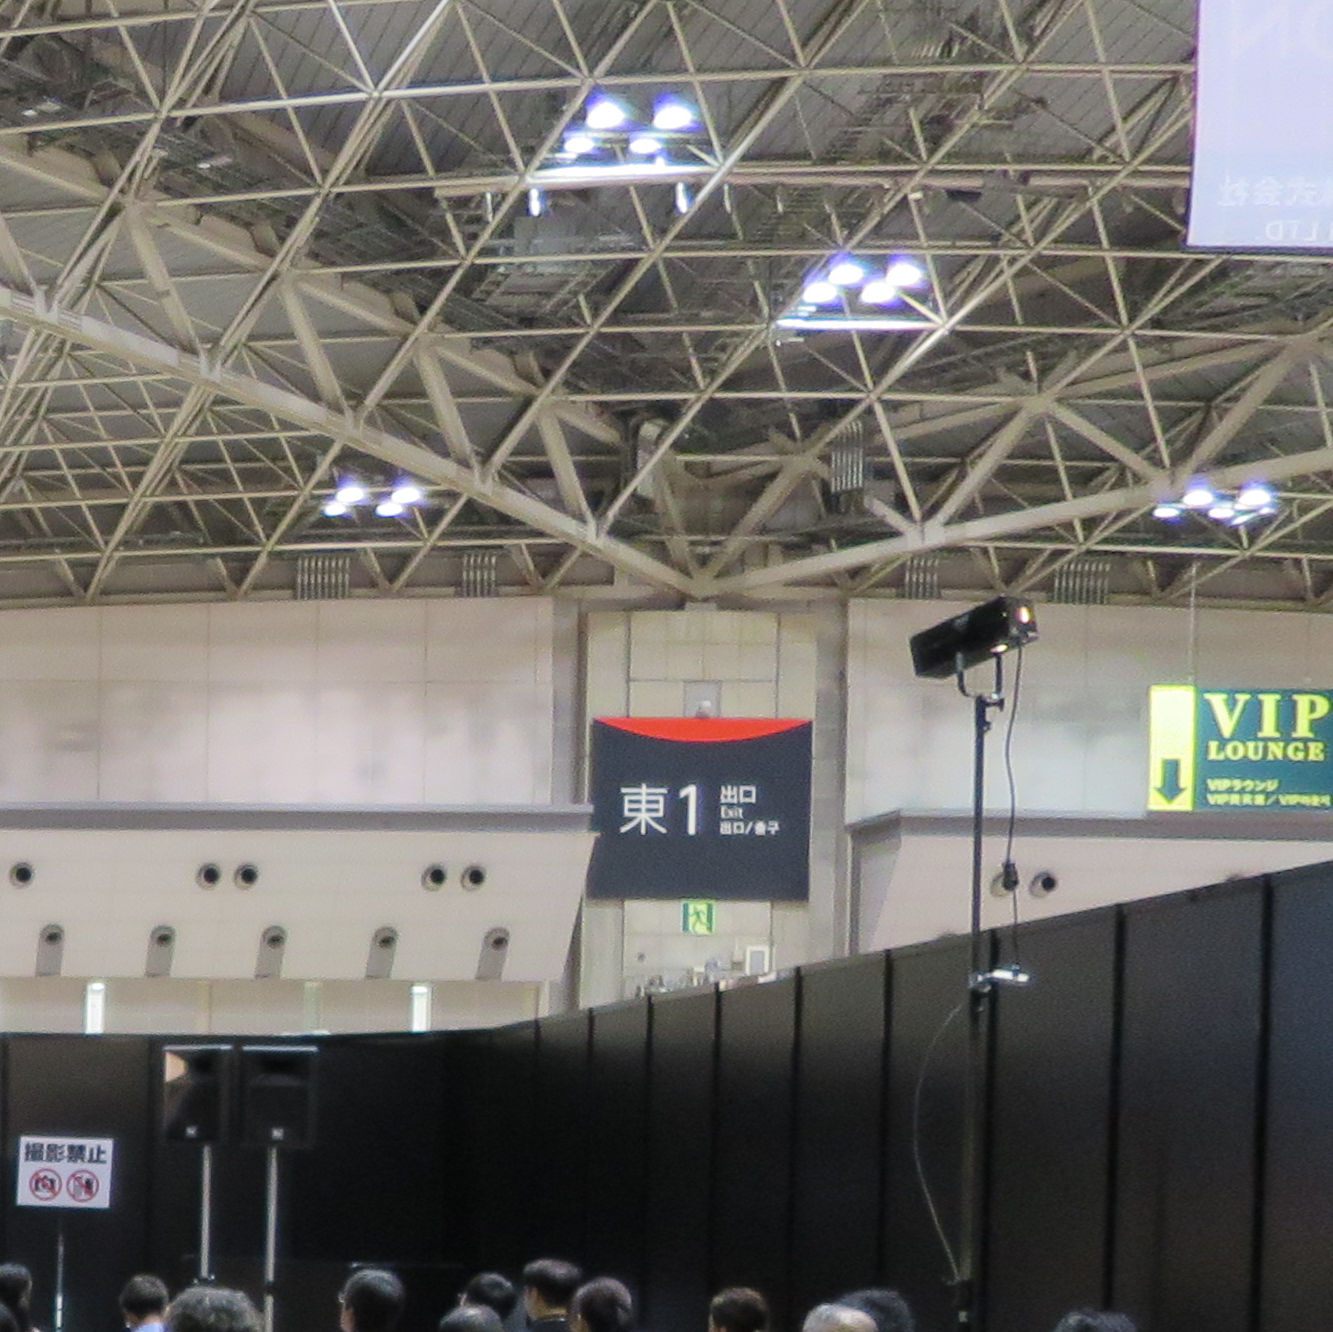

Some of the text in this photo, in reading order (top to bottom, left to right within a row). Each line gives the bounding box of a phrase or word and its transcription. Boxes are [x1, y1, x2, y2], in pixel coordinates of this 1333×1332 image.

[1203, 692, 1331, 739] VIP
[1207, 740, 1326, 761] LOUNGE
[719, 785, 757, 804] 出口
[720, 805, 744, 819] Exit
[24, 1142, 107, 1164] 撮影禁止
